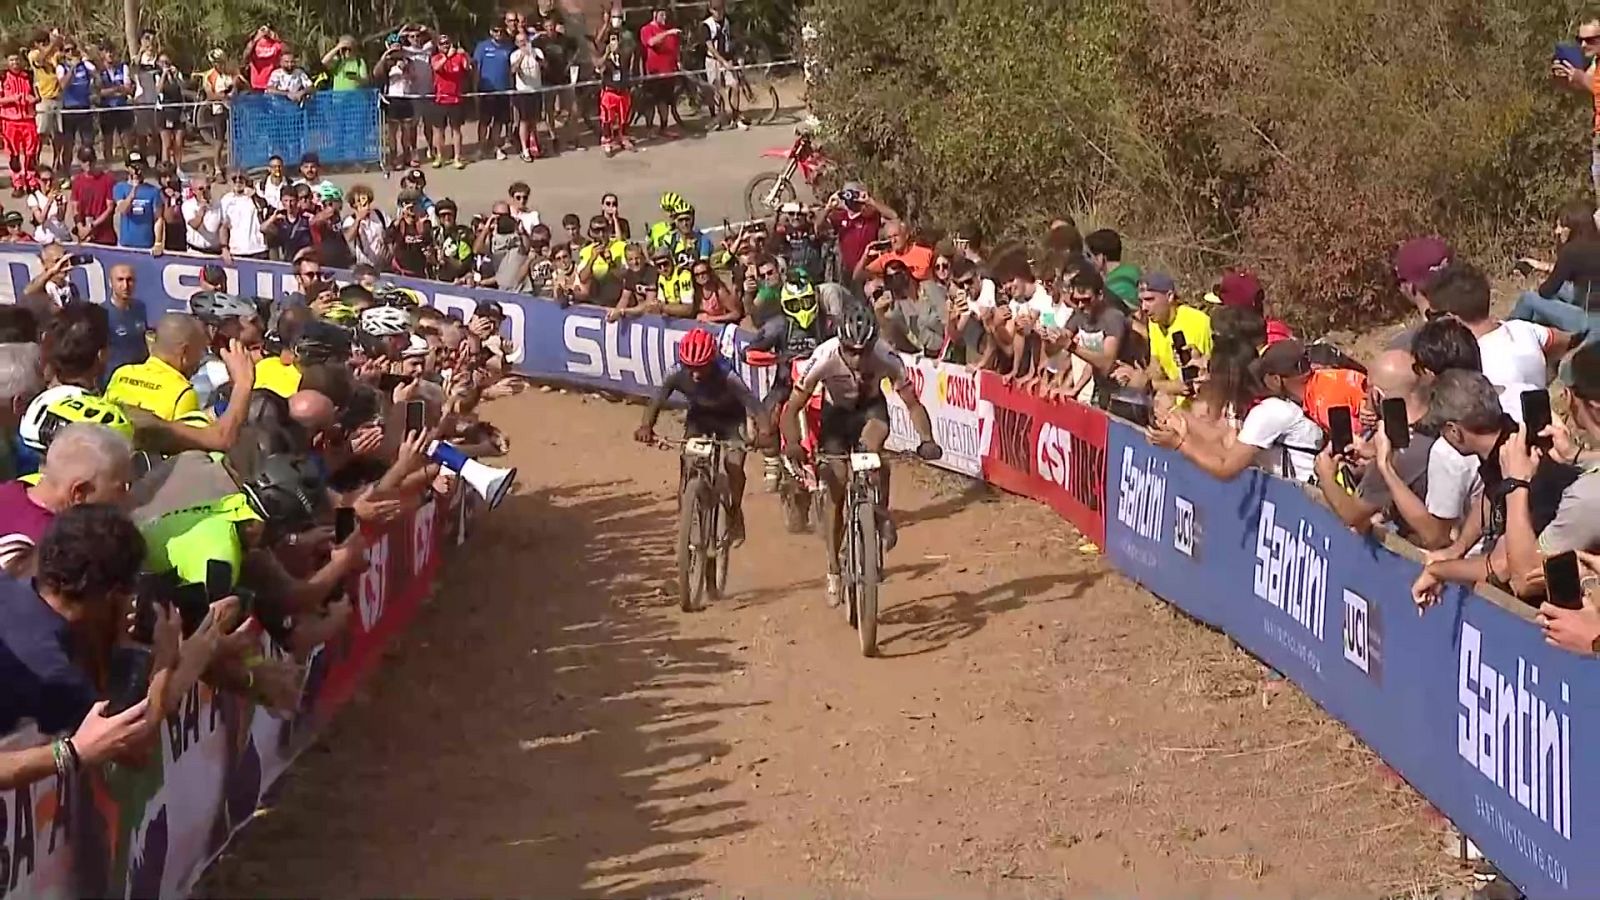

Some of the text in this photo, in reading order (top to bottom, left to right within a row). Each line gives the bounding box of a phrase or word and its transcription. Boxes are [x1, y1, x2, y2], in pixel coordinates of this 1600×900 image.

[1037, 421, 1071, 491] CST
[1118, 445, 1167, 543] Santini
[1254, 500, 1331, 642] Santini
[1345, 598, 1368, 666] UCI
[1458, 621, 1570, 840] Santini
